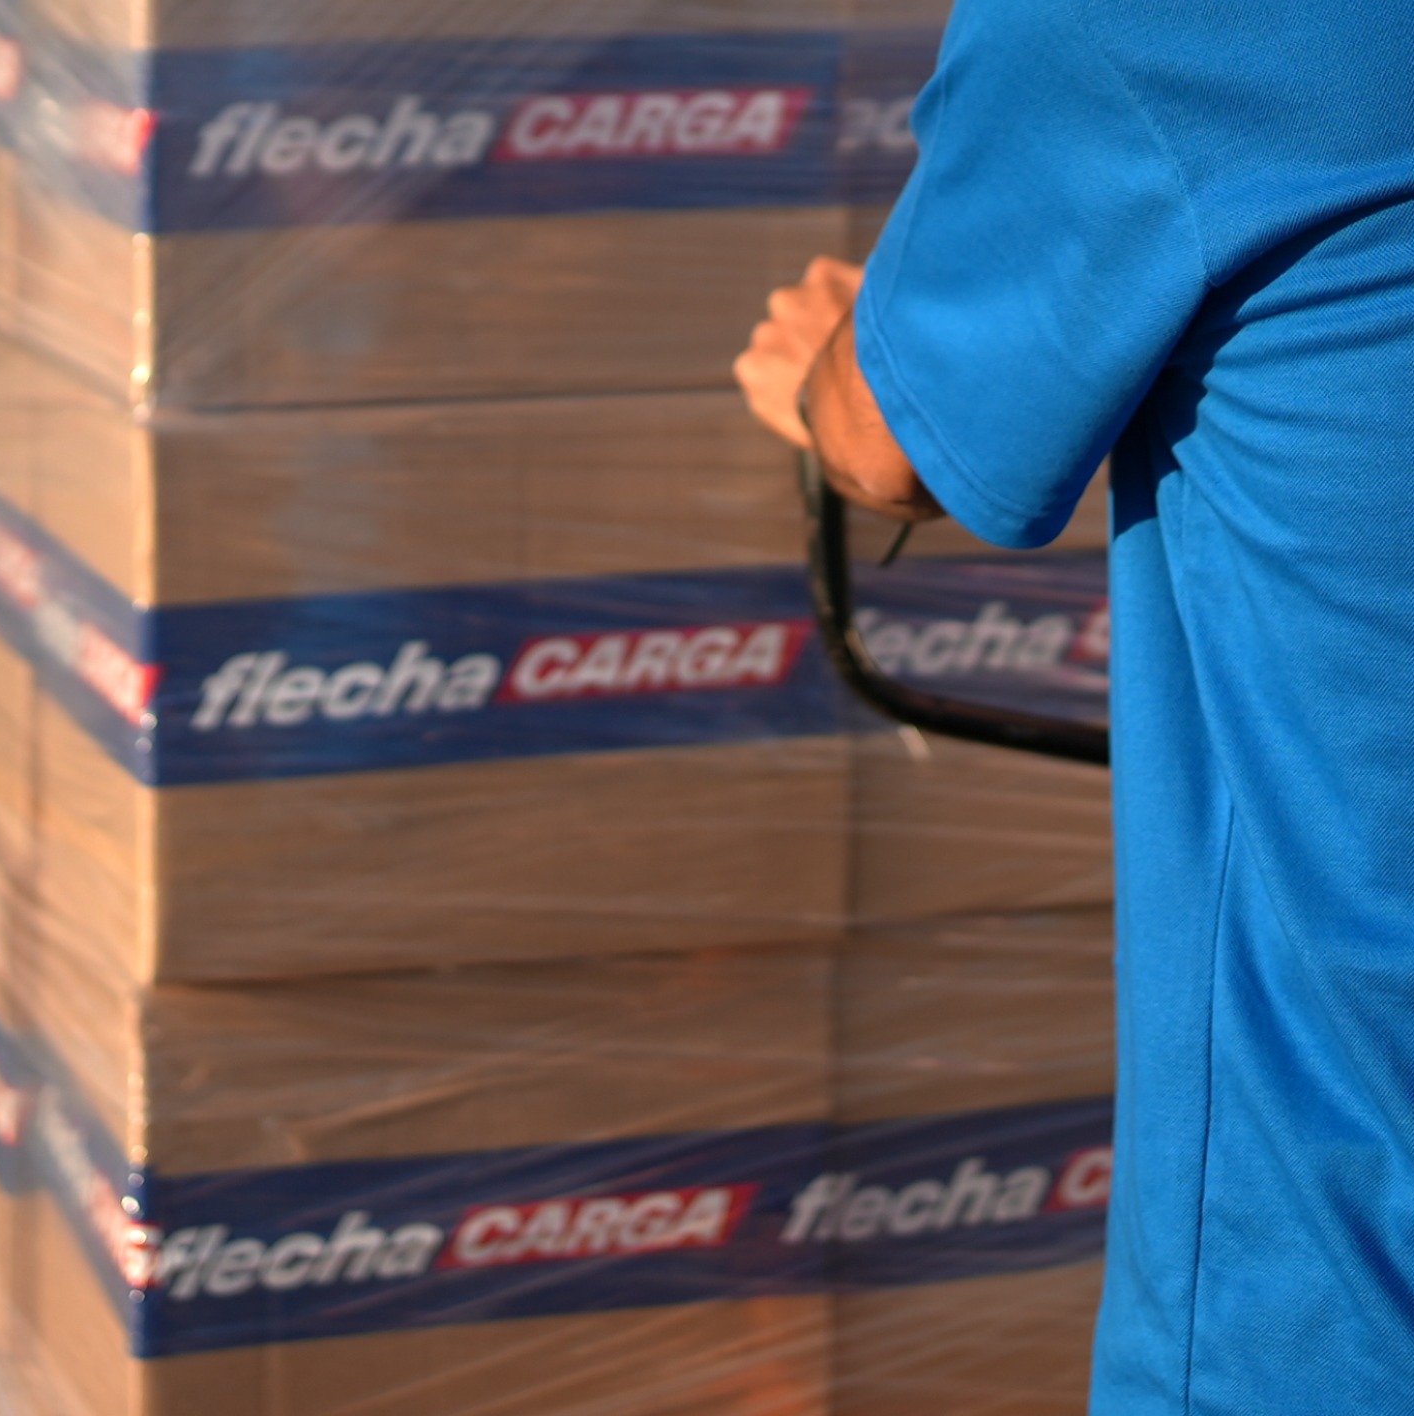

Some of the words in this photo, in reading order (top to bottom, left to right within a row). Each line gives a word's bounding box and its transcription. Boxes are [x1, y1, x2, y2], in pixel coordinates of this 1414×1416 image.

[189, 94, 497, 178] flecha
[507, 88, 787, 156] CARGA
[189, 640, 502, 730] flecha
[511, 627, 785, 698] CARGA
[453, 1188, 729, 1266] CARGA
[783, 1156, 1051, 1246] flecha
